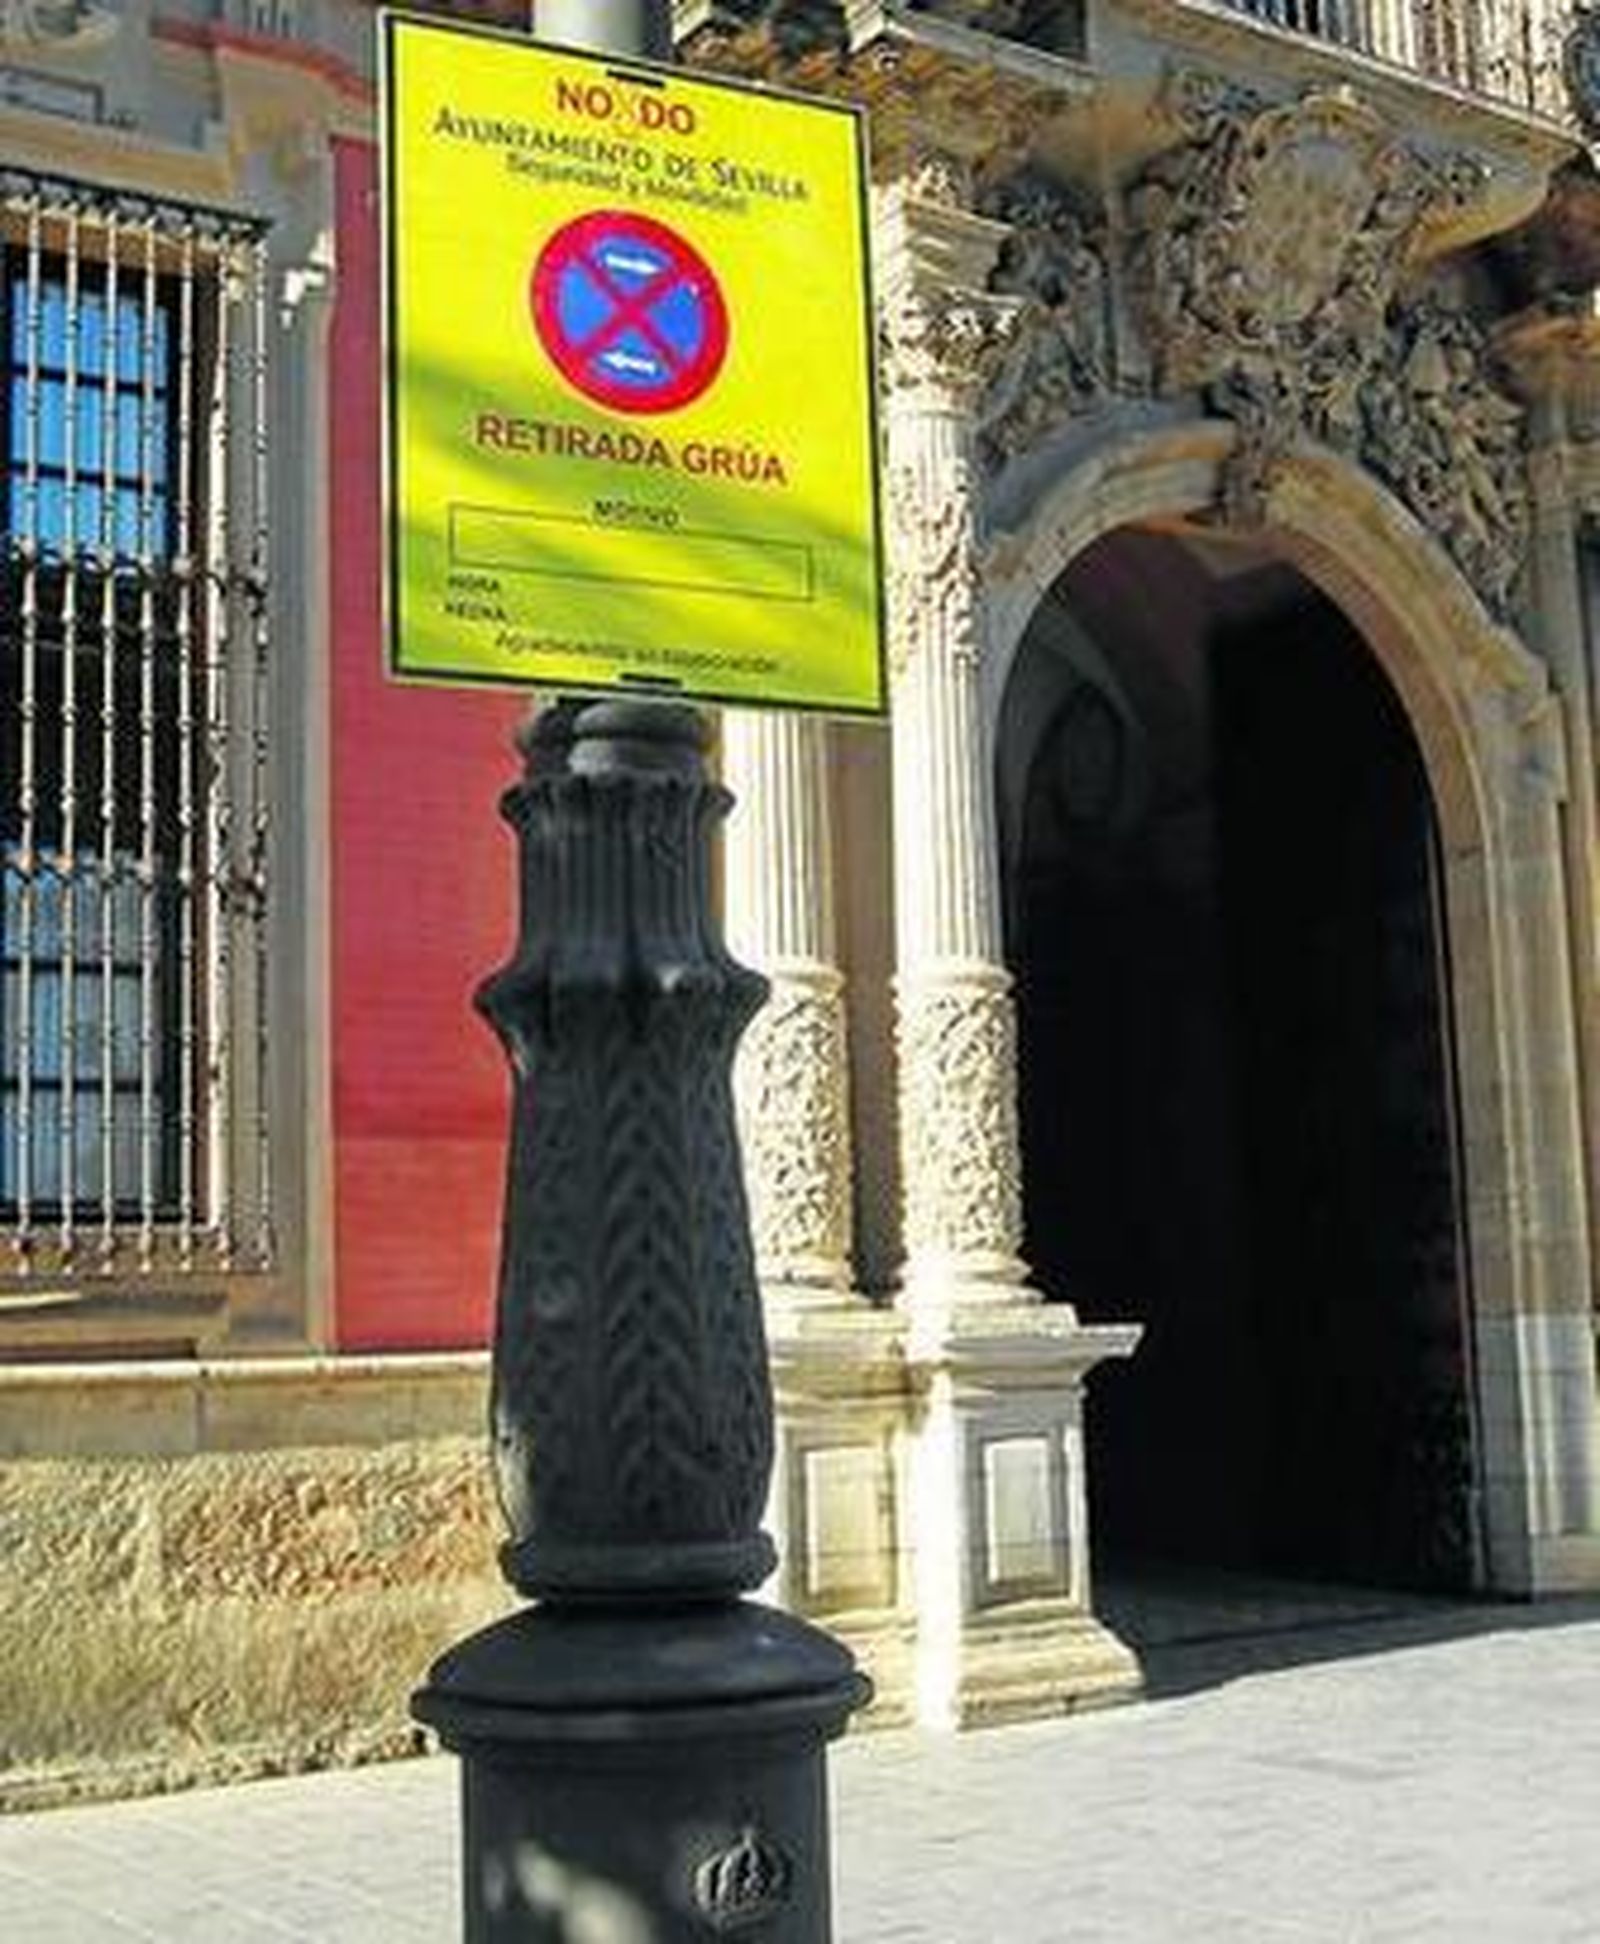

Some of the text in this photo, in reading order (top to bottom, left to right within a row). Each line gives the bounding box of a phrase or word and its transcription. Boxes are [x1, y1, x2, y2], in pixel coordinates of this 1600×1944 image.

[433, 106, 652, 172] AYUNTAMIENTO
[665, 152, 696, 181] DE
[711, 157, 809, 200] SEVILLA
[476, 413, 789, 487] RETIRADA GRÚA
